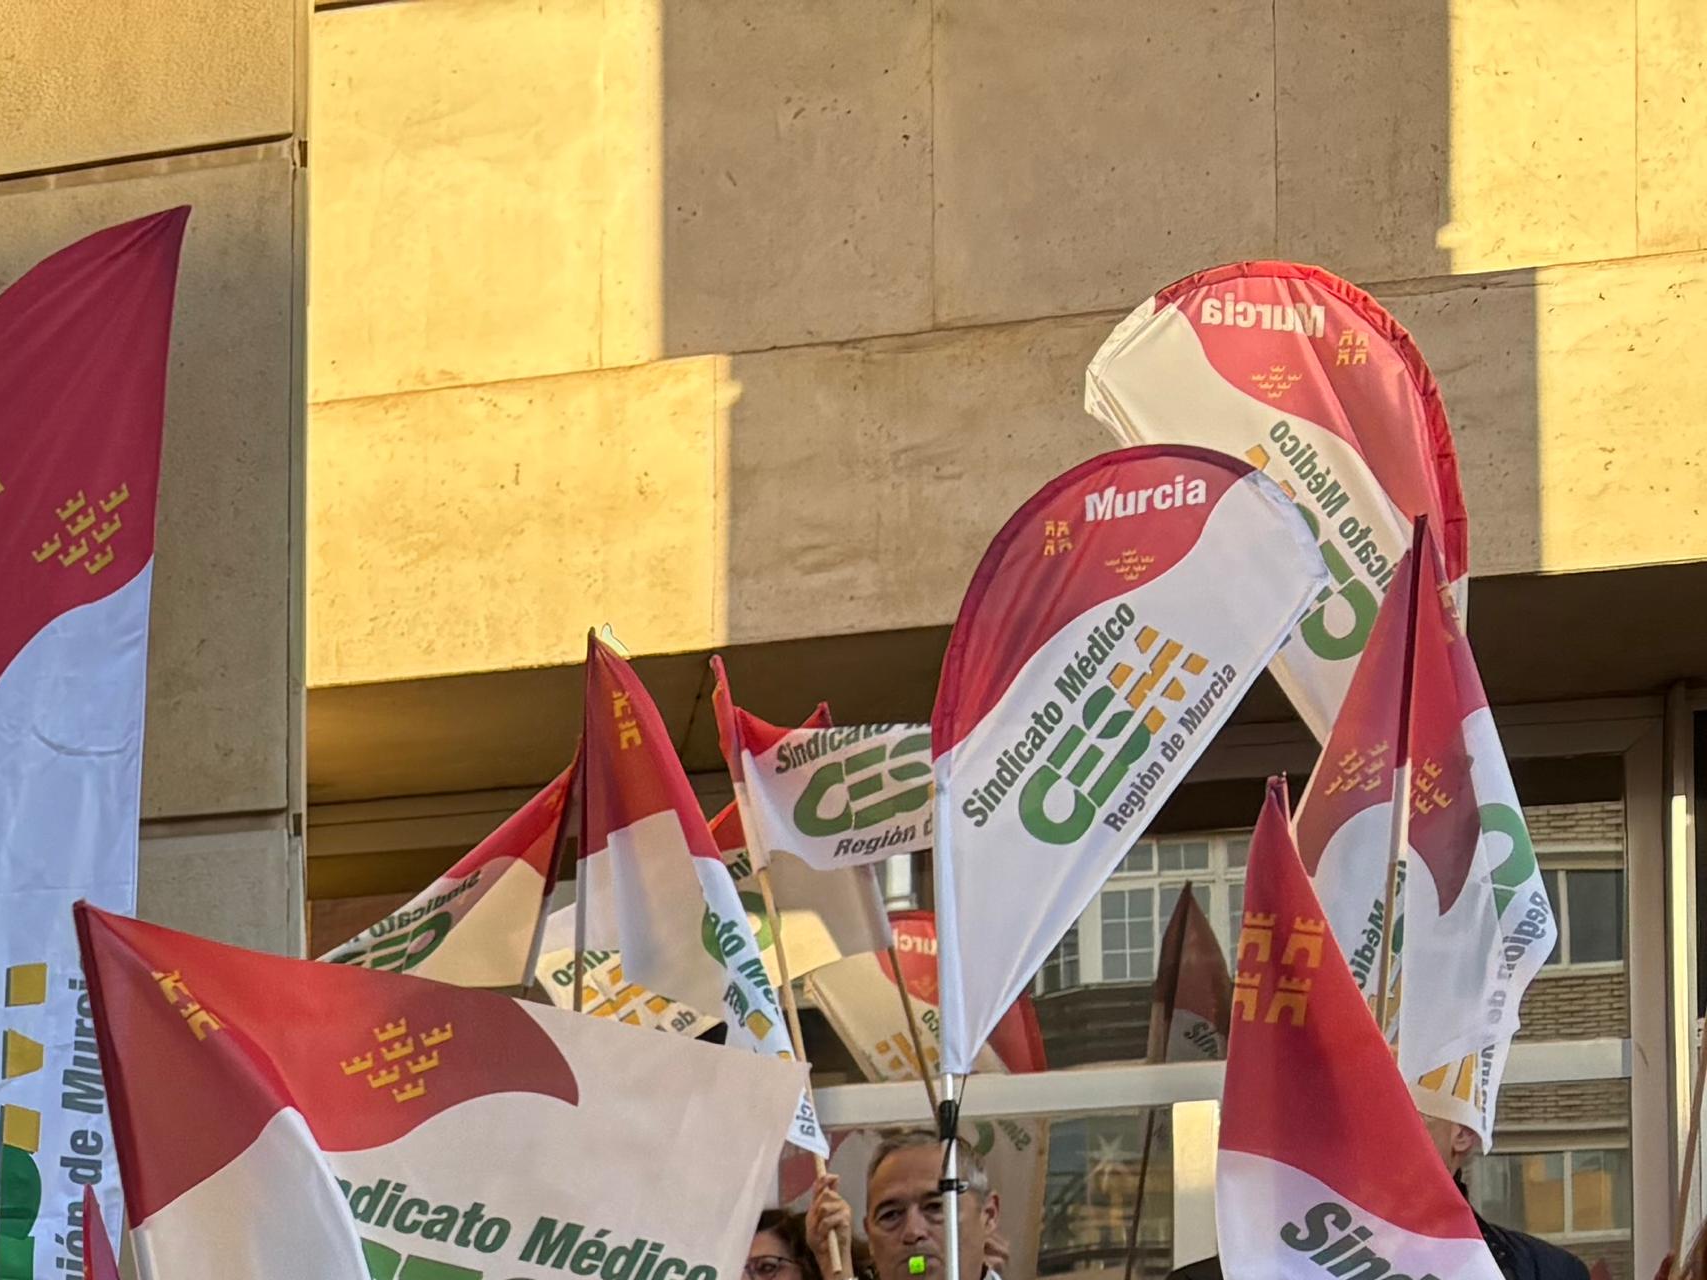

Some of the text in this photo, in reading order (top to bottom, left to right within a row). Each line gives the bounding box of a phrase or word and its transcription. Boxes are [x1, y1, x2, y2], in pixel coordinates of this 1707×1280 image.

[1084, 474, 1207, 525] Murcia
[962, 602, 1135, 828] Sindicato Médico
[1019, 624, 1209, 845] CESM
[1103, 663, 1237, 832] Región de Murcia
[833, 825, 916, 858] Región
[60, 1128, 104, 1185] de
